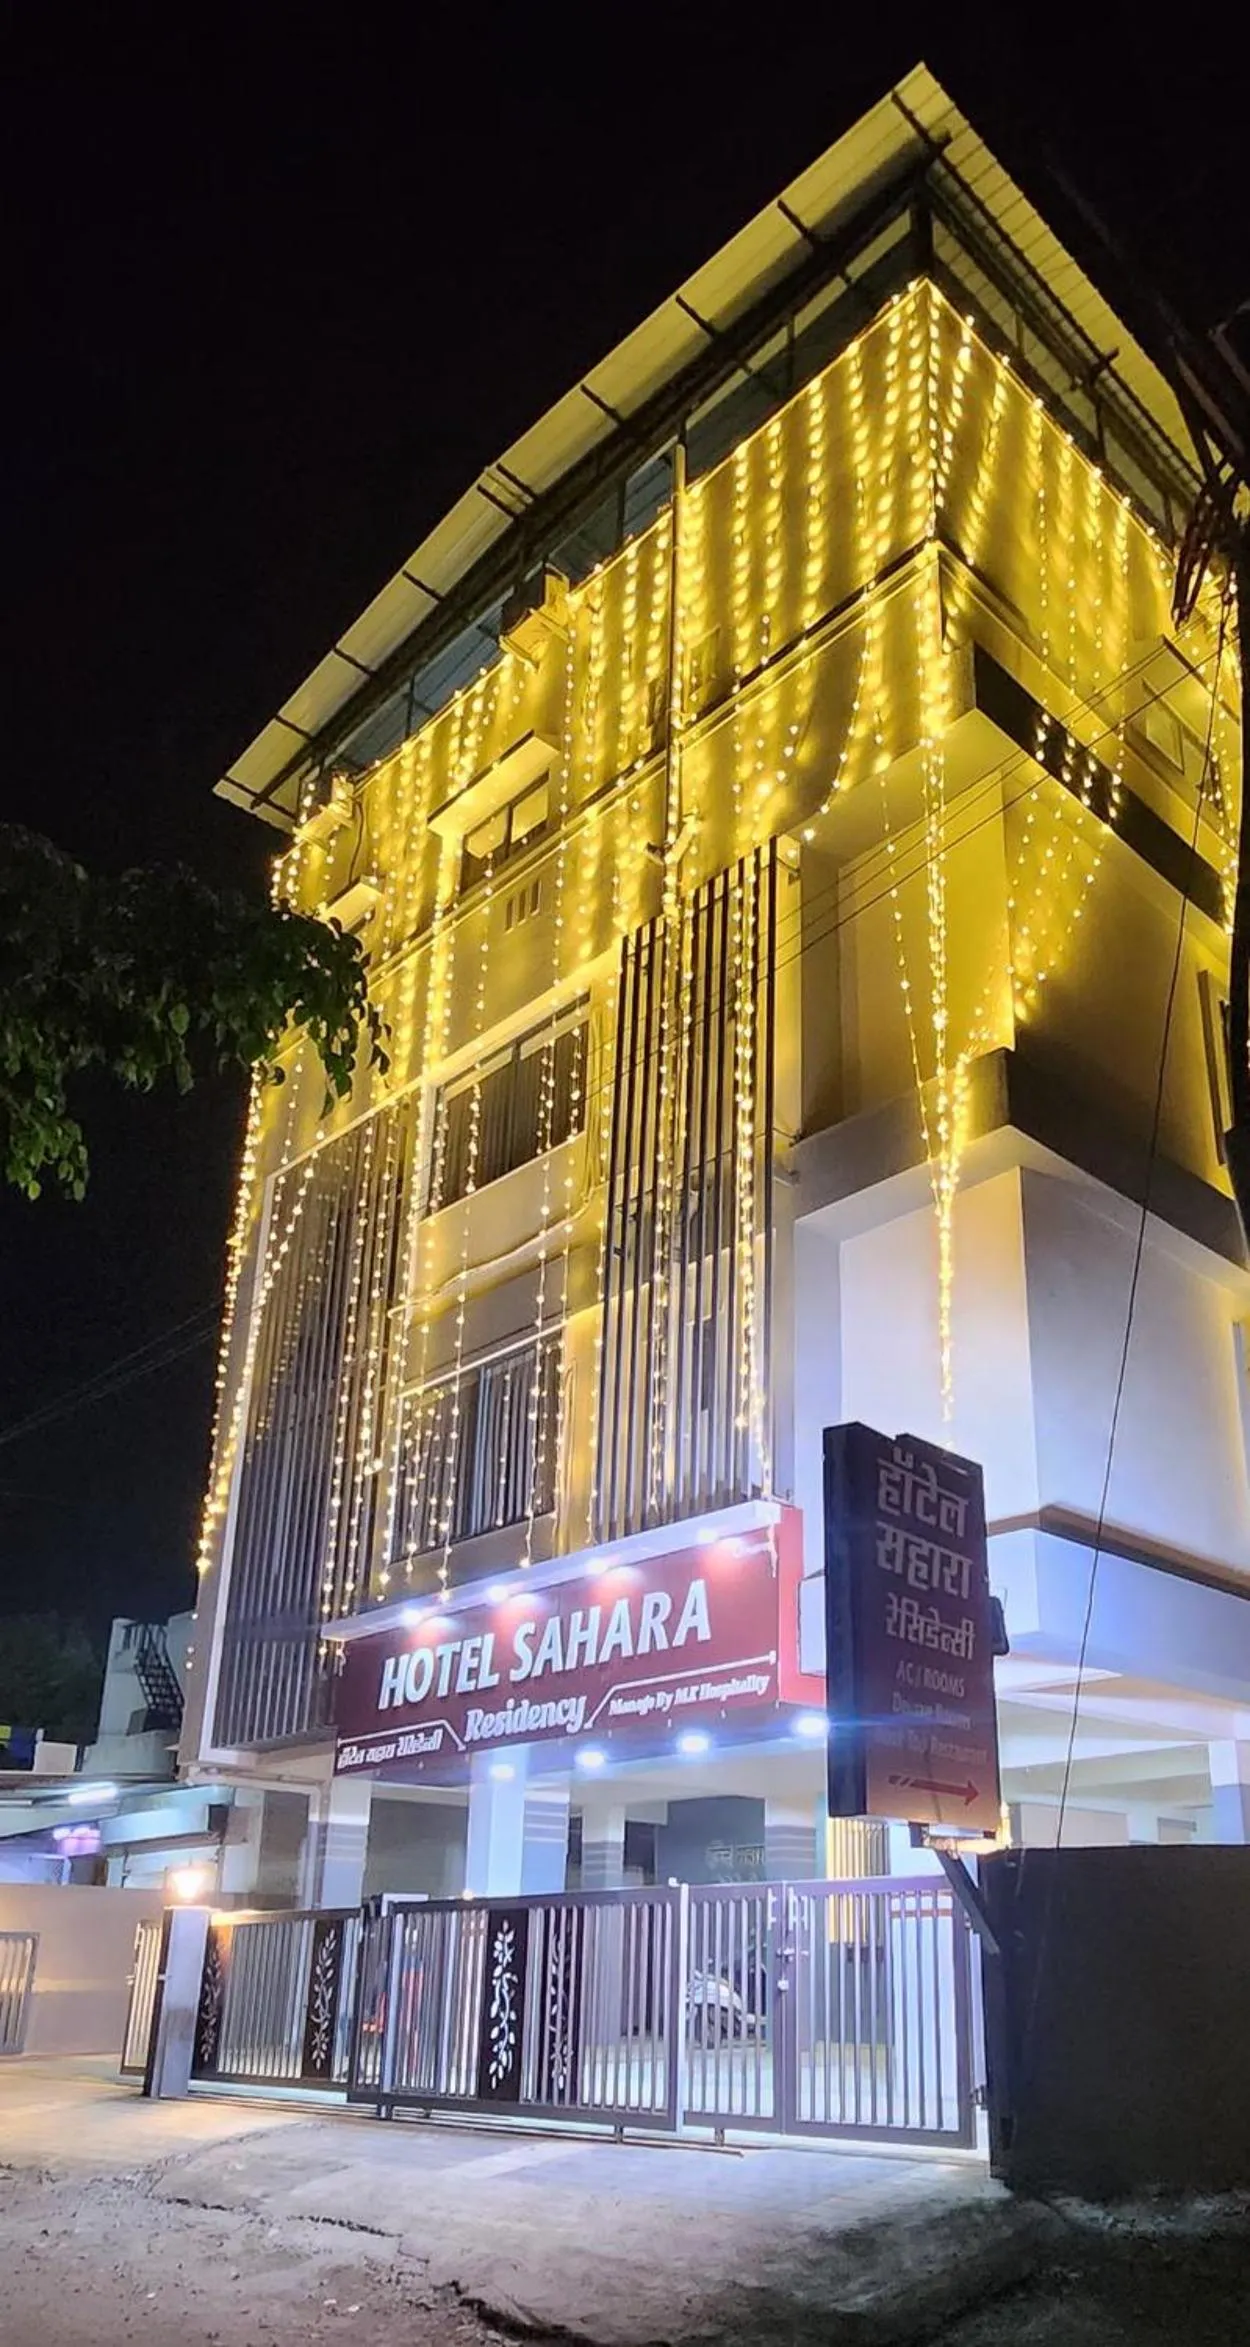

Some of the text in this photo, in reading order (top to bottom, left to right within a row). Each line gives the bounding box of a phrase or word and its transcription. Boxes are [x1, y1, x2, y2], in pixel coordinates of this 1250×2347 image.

[876, 1447, 969, 1538] हॉटेल
[875, 1520, 973, 1600] सहारा
[378, 1579, 712, 1710] HOTEL SAHARA
[463, 1695, 588, 1742] Residency
[699, 1674, 770, 1701] Hospitality
